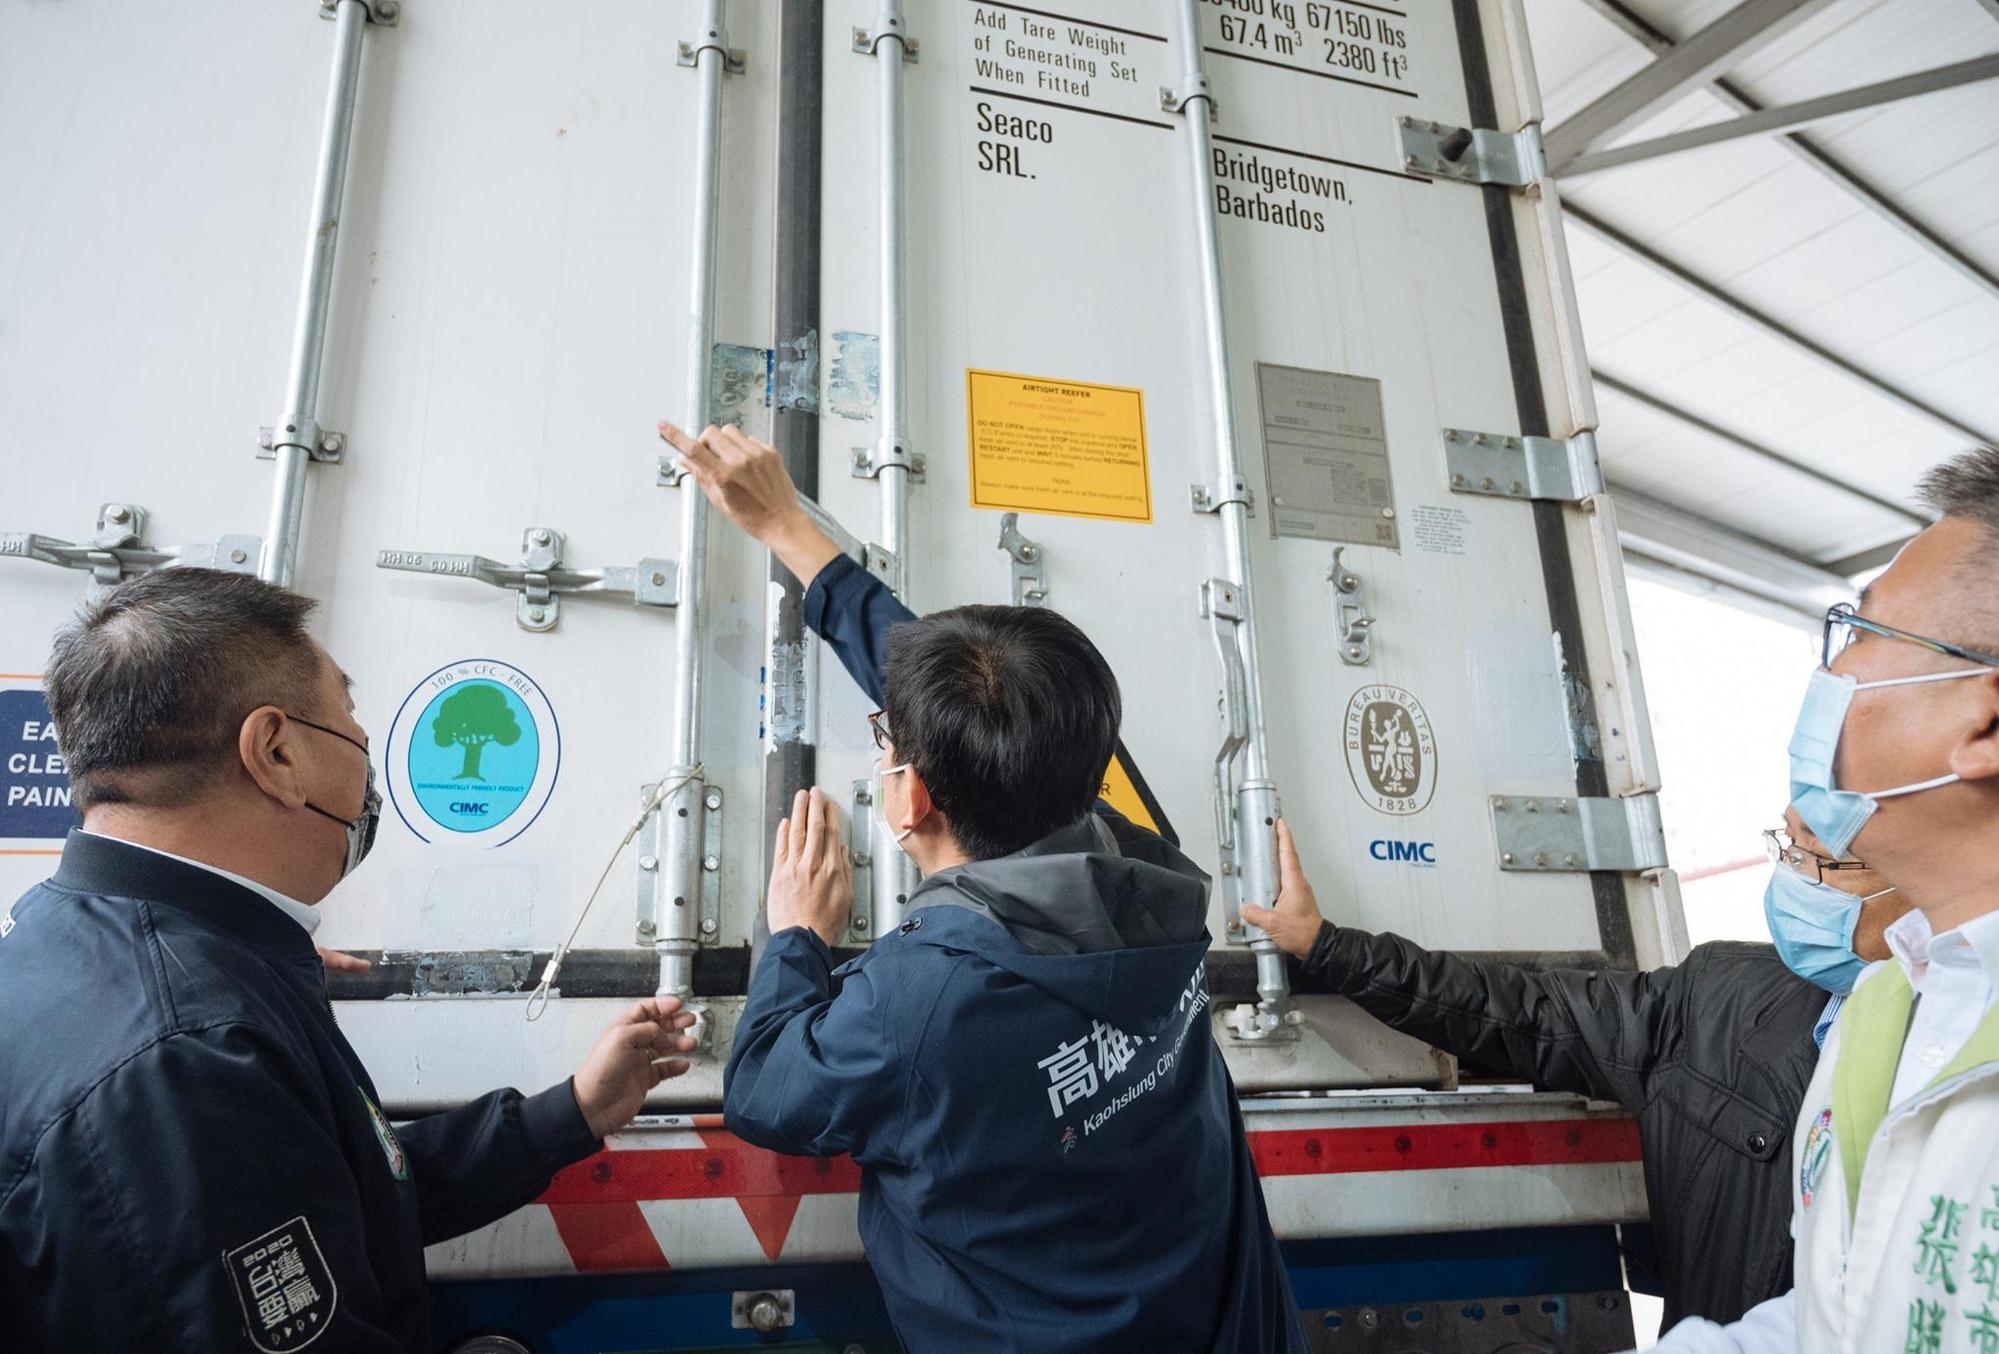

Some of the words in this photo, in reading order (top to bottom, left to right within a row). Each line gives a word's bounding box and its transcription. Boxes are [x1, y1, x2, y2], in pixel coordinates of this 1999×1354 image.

[974, 8, 1006, 31] Add
[1020, 17, 1055, 41] Tare
[1068, 27, 1126, 56] Weight
[1271, 0, 1295, 30] kg
[1306, 2, 1371, 41] 67150
[1377, 18, 1406, 49] lbs
[974, 35, 991, 51] of
[1005, 39, 1097, 78] Generating
[1110, 61, 1138, 83] Set
[1220, 14, 1267, 49] 67.4
[1323, 37, 1376, 73] 2380
[975, 58, 1025, 85] When
[1038, 70, 1090, 98] Fitted
[976, 102, 1053, 144] Seaco
[978, 140, 1036, 180] SRL.
[1216, 184, 1325, 233] Barbados
[1022, 384, 1059, 394] AIRTIGHT
[1061, 389, 1091, 398] REEFER
[1005, 423, 1025, 431] OPEN
[1050, 435, 1068, 443] STOP
[979, 444, 1010, 453] RESTART
[1103, 457, 1140, 467] RETURNING
[431, 672, 454, 689] 100
[474, 665, 497, 677] CFC
[508, 674, 533, 696] FREE
[22, 721, 59, 741] EA
[1349, 688, 1382, 750] BUREAU
[1388, 689, 1431, 755] VERITAS
[8, 753, 69, 774] CLE
[8, 786, 72, 807] PAIN
[449, 802, 489, 814] CIMC
[1379, 797, 1416, 811] 1828
[1370, 840, 1436, 863] CIMC
[1083, 1071, 1156, 1136] Kaohsiung
[1157, 1049, 1175, 1077] City
[242, 1234, 293, 1268] 2020
